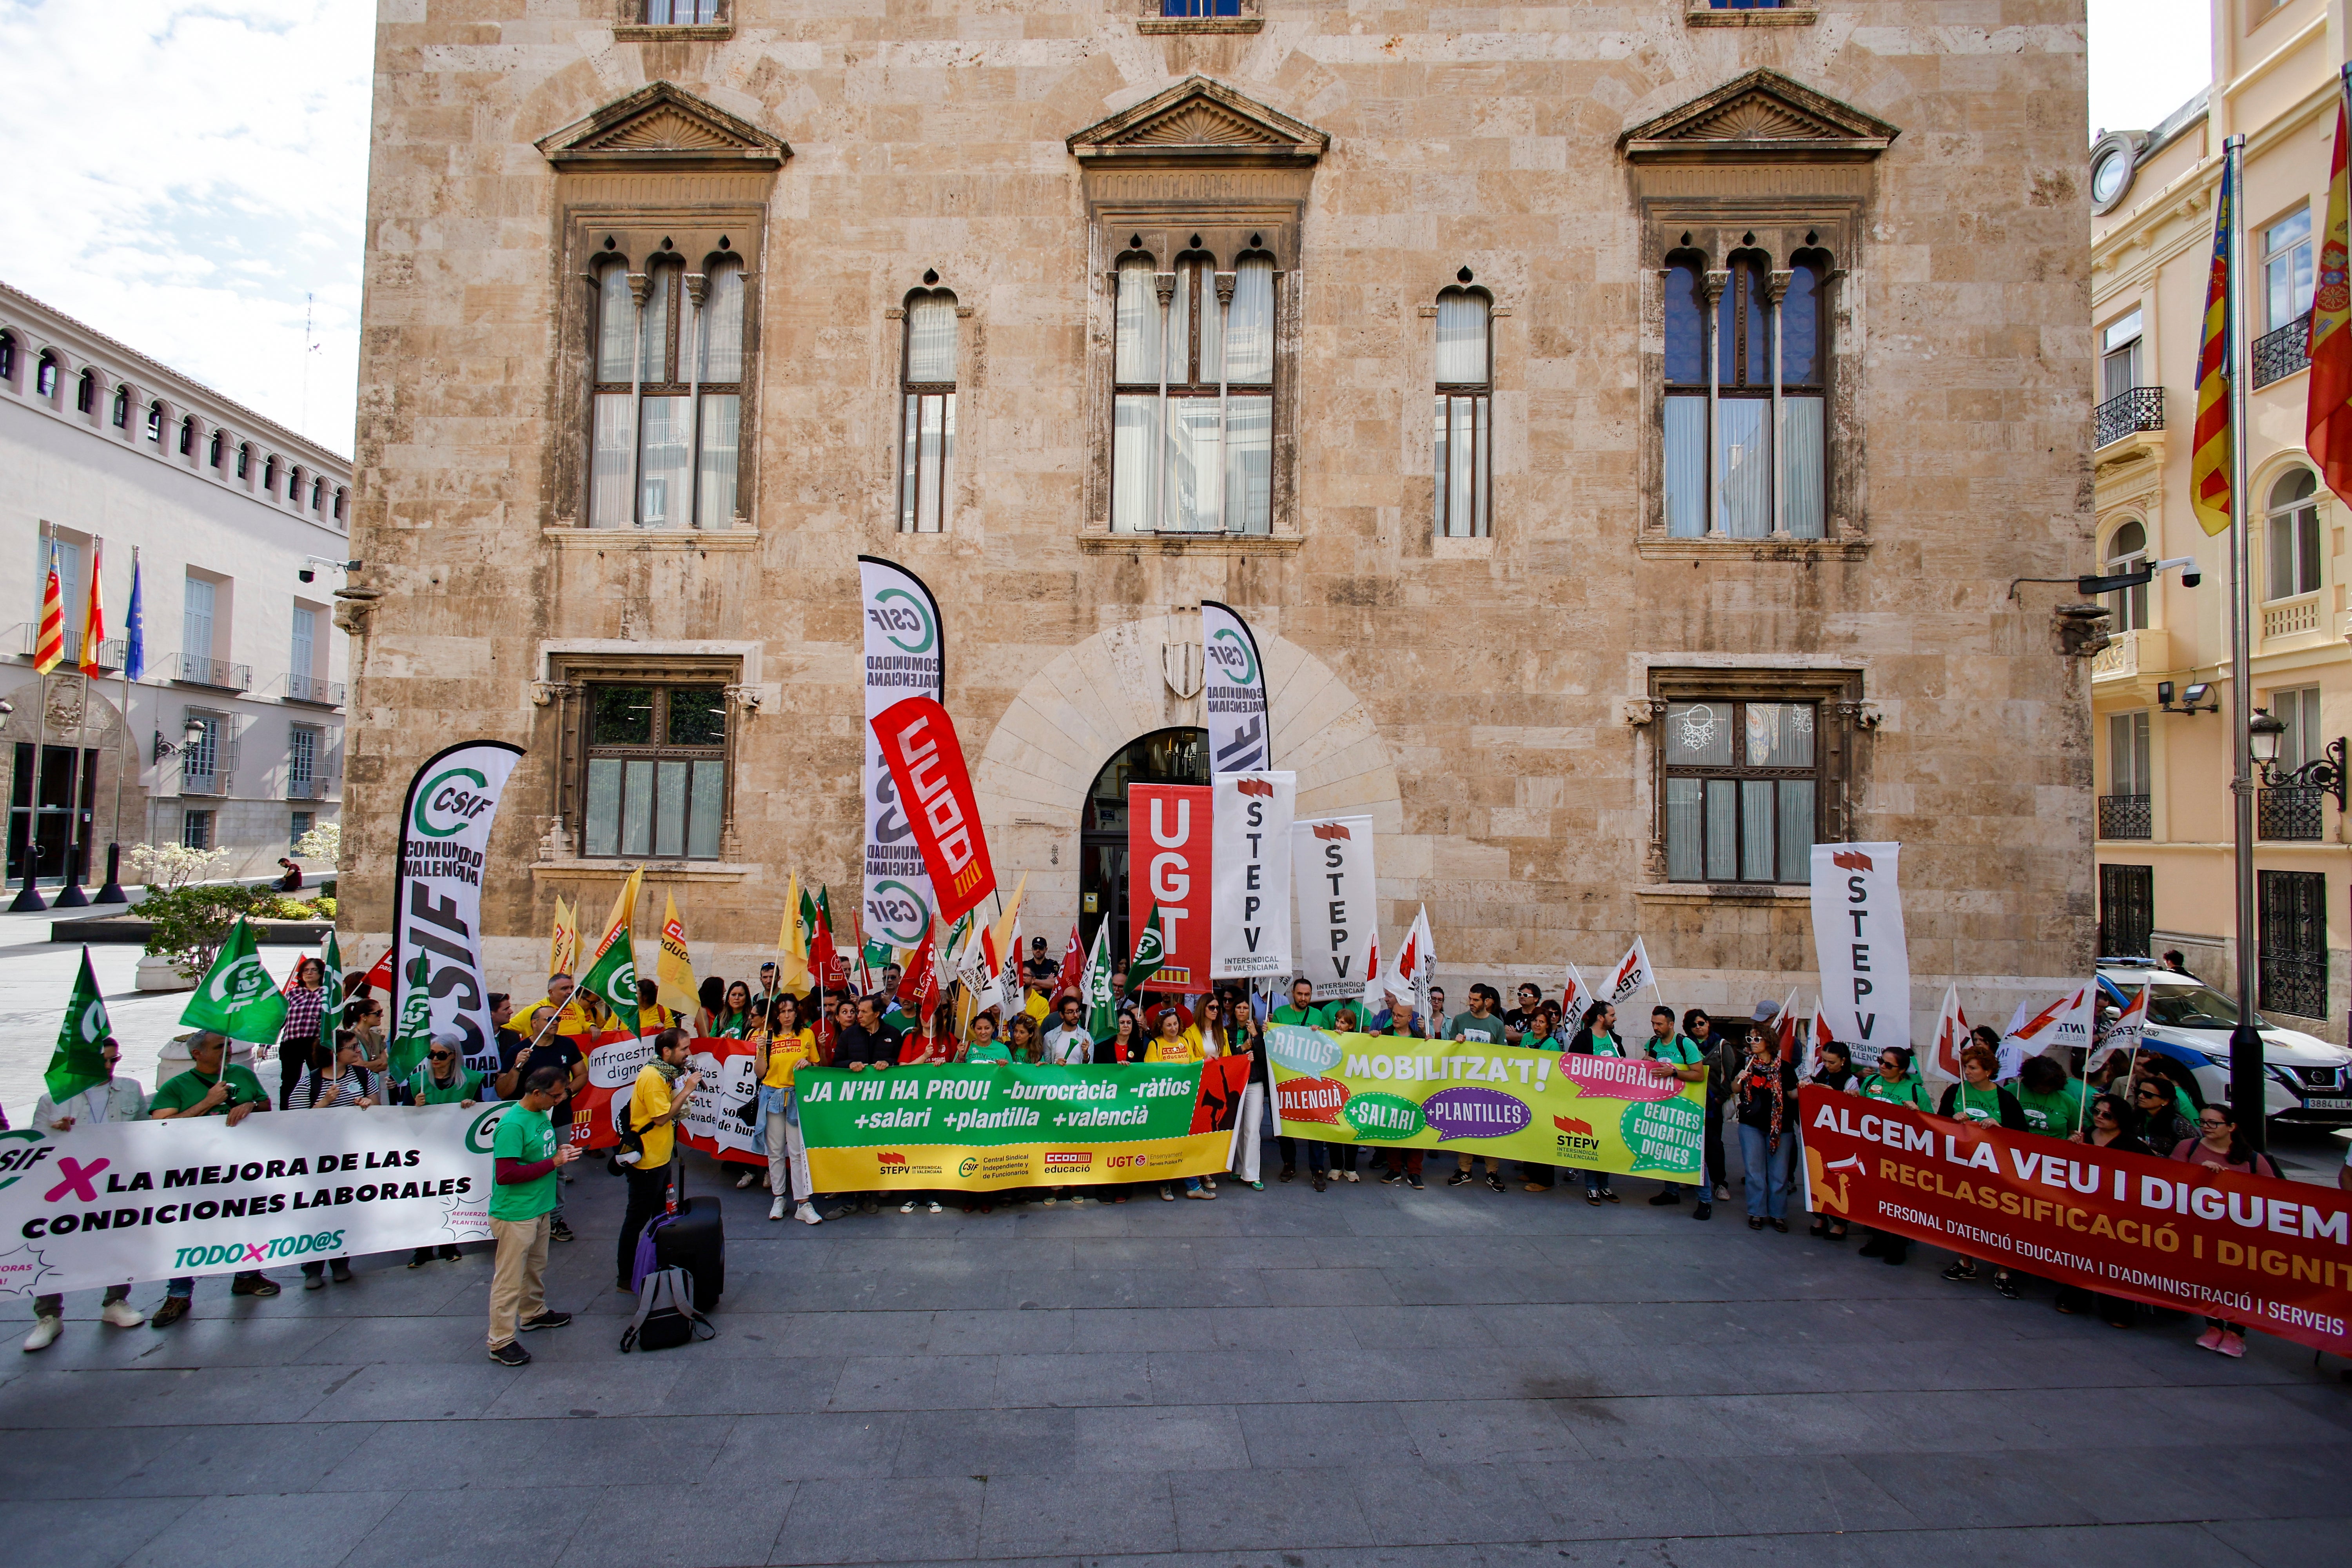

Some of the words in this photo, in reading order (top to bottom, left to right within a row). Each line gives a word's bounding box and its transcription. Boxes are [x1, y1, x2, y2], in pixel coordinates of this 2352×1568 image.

[434, 787, 494, 819] CSIF
[897, 715, 975, 875] CCOO
[1150, 798, 1190, 955] UGT
[1244, 802, 1263, 953] STEPV
[1325, 844, 1350, 979] STEPV
[1225, 956, 1279, 964] INTERSINDICAL
[1234, 964, 1279, 972] VALENCIANA
[1847, 876, 1876, 1040] STEPV
[1317, 981, 1365, 990] INTERSINDICA
[1326, 988, 1365, 996] VALENCIAN
[591, 1046, 655, 1067] infraestr
[1267, 1031, 1334, 1066] -RÀTIOS
[608, 1063, 647, 1082] digne
[1345, 1054, 1552, 1092] MOBILITZA'T!
[803, 1082, 832, 1103] JA
[889, 1080, 919, 1100] HA
[926, 1080, 991, 1100] PROU!
[1003, 1080, 1118, 1100] -burocràcia
[1130, 1077, 1191, 1098] -ràtios
[693, 1097, 712, 1108] olt
[1427, 1102, 1521, 1124] +PLANTILLES
[2310, 1099, 2332, 1108] 3884
[2335, 1100, 2352, 1109] LLM
[718, 1119, 731, 1132] de
[735, 1123, 756, 1137] bur
[854, 1107, 932, 1129] +salari
[943, 1107, 1040, 1132] +plantilla
[1052, 1105, 1148, 1127] +valencià
[1349, 1102, 1416, 1131] +SALARI
[1644, 1102, 1700, 1131] CENTRES
[1557, 1135, 1599, 1151] STEPV
[1633, 1118, 1703, 1151] EDUCATIUS
[0, 1146, 56, 1172] SIF
[1107, 1156, 1134, 1168] UGT
[1150, 1151, 1183, 1160] Ensenyament
[1557, 1146, 1599, 1157] INTERSINDICAL
[1563, 1152, 1599, 1161] VALENCIANA
[1641, 1138, 1689, 1166] DIGNES
[107, 1171, 154, 1193] LA
[163, 1157, 309, 1189] MEJORA
[316, 1153, 359, 1174] DE
[365, 1149, 421, 1169] LAS
[880, 1165, 910, 1174] STEPV
[962, 1162, 979, 1171] CSIF
[983, 1162, 1023, 1171] Independiente
[992, 1169, 1029, 1179] Funcionarios
[1045, 1164, 1091, 1174] educació
[1813, 1104, 1934, 1158] ALCEM
[1945, 1134, 2000, 1174] LA
[2009, 1147, 2100, 1194] VEU
[2113, 1169, 2126, 1201] I
[2140, 1174, 2348, 1245] DIGUEM
[22, 1194, 287, 1239] CONDICIONES
[292, 1176, 472, 1210] LABORALES
[1880, 1157, 2180, 1253] RECLASSIFICACIÓ
[2193, 1234, 2203, 1259] I
[2217, 1239, 2352, 1292] DIGNIT
[1878, 1200, 1943, 1231] PERSONAL
[1946, 1219, 2011, 1251] D'ATENCIÓ
[2015, 1240, 2095, 1273] EDUCATIVA
[2098, 1261, 2103, 1275] I
[2108, 1263, 2251, 1311] D'ADMINISTRACIÓ
[2257, 1298, 2262, 1314] I
[2267, 1301, 2344, 1336] SERVEIS
